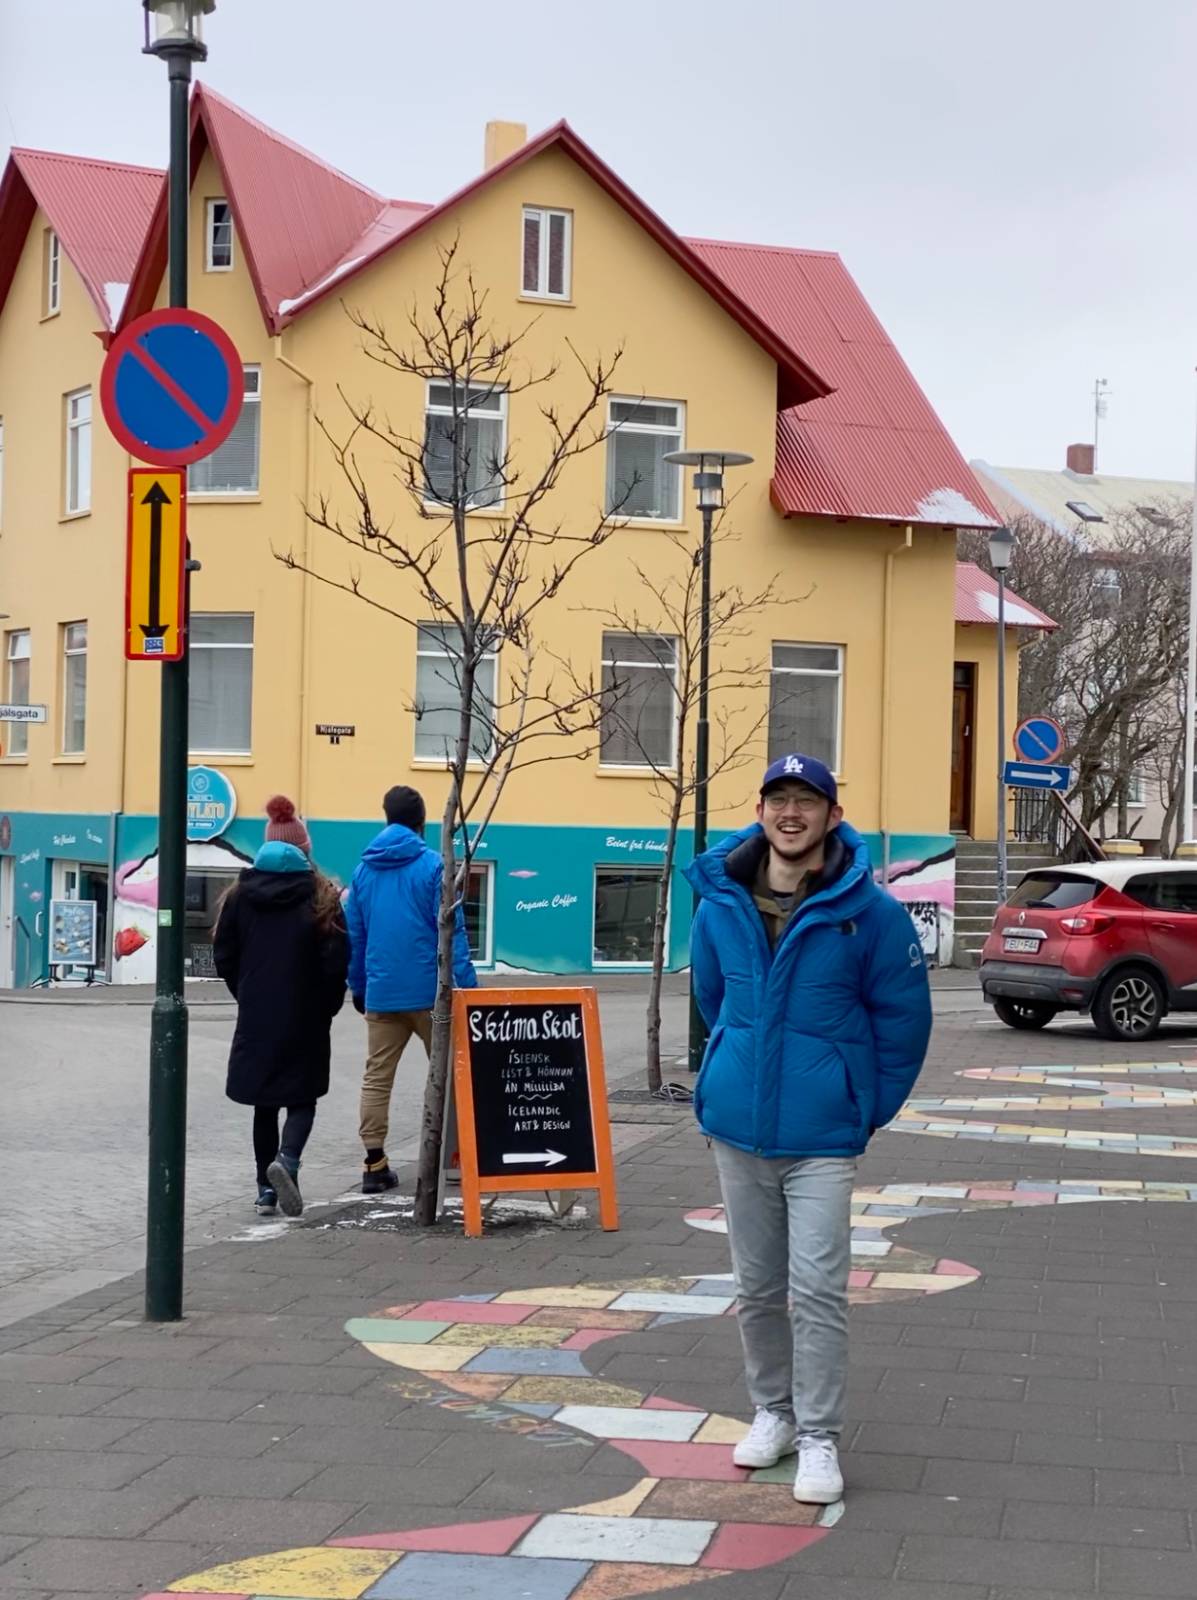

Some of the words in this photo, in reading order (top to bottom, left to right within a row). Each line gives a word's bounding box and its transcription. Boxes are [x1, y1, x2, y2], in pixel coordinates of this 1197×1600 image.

[784, 755, 803, 773] LA
[605, 836, 629, 848] Beint
[516, 900, 549, 912] Organic
[551, 893, 577, 907] Coffee
[469, 1010, 540, 1042] Skúma
[541, 1010, 582, 1040] Skot
[508, 1048, 551, 1065] ÍSLENSK
[508, 1104, 562, 1117] ICELANDIC
[543, 1120, 571, 1131] DESIGN
